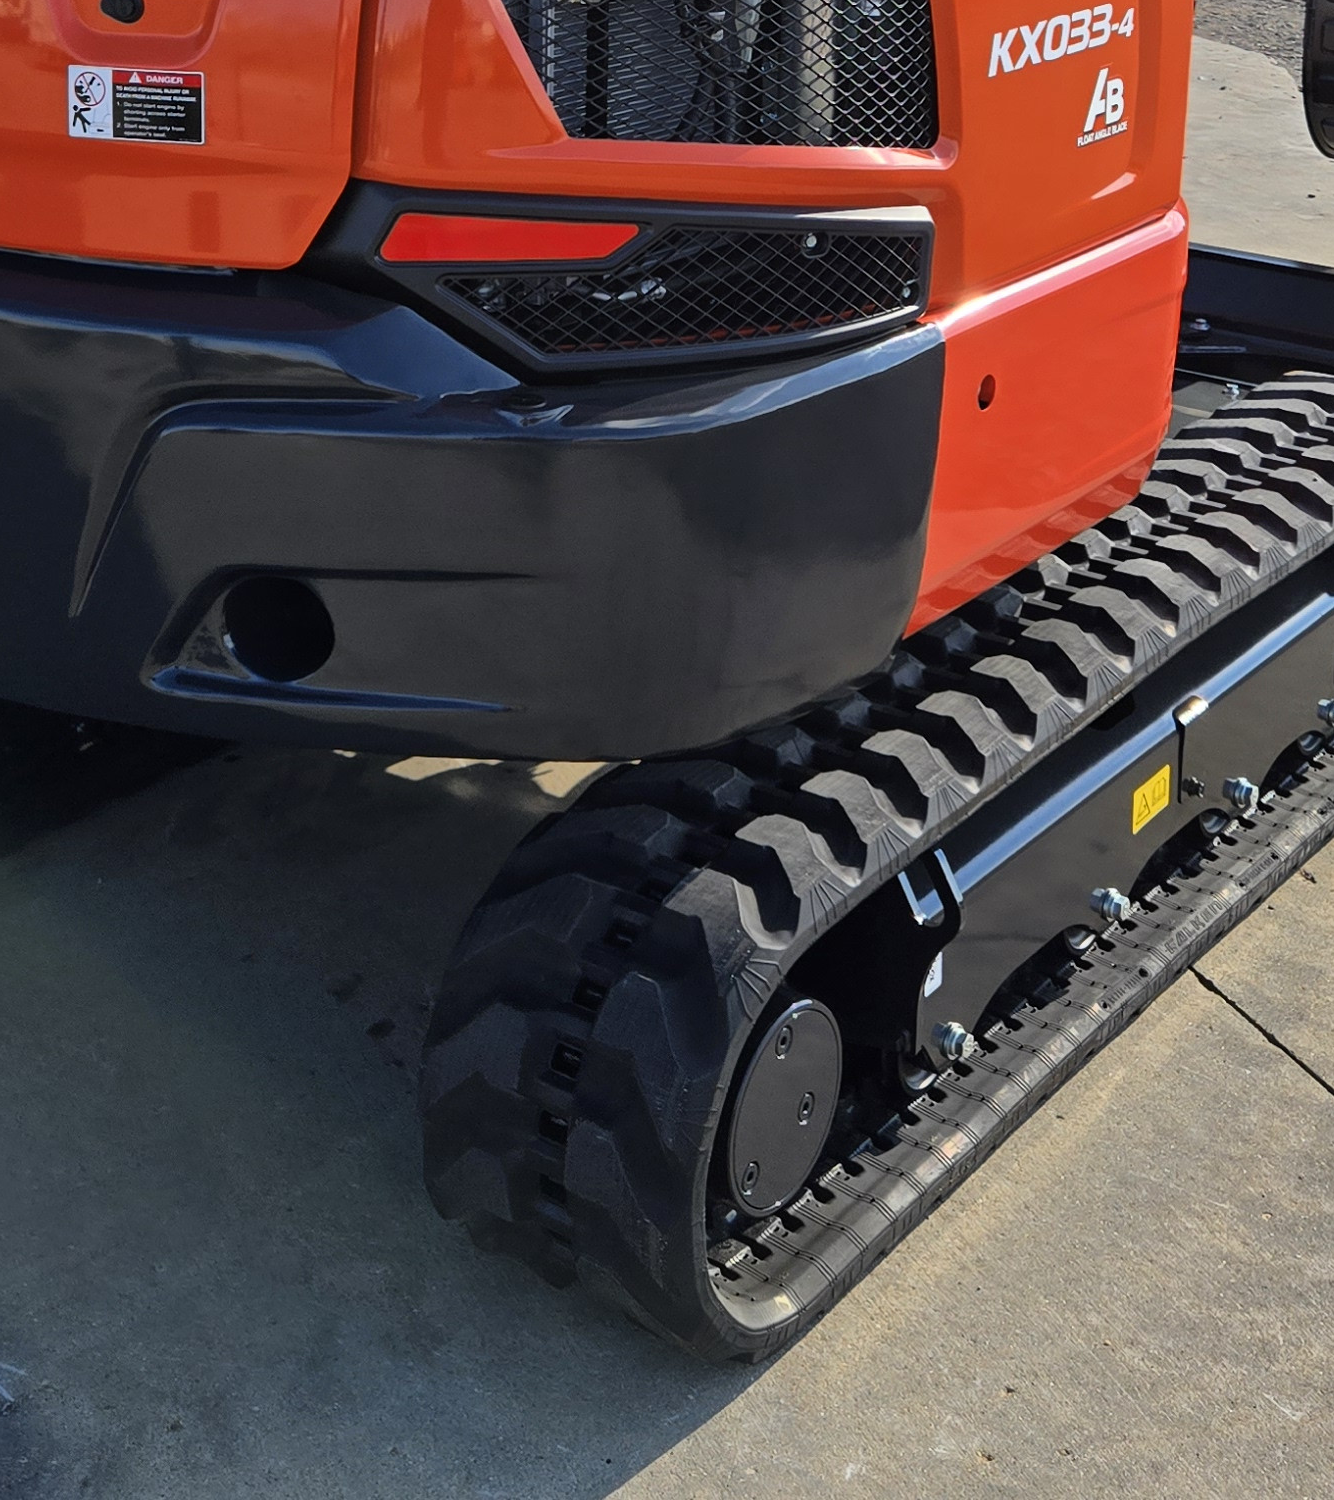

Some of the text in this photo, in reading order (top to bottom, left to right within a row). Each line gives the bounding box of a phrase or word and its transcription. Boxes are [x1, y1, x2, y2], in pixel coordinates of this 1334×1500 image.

[987, 3, 1135, 78] KX033-4
[146, 75, 183, 84] DANGER
[1077, 132, 1095, 147] FLOAT
